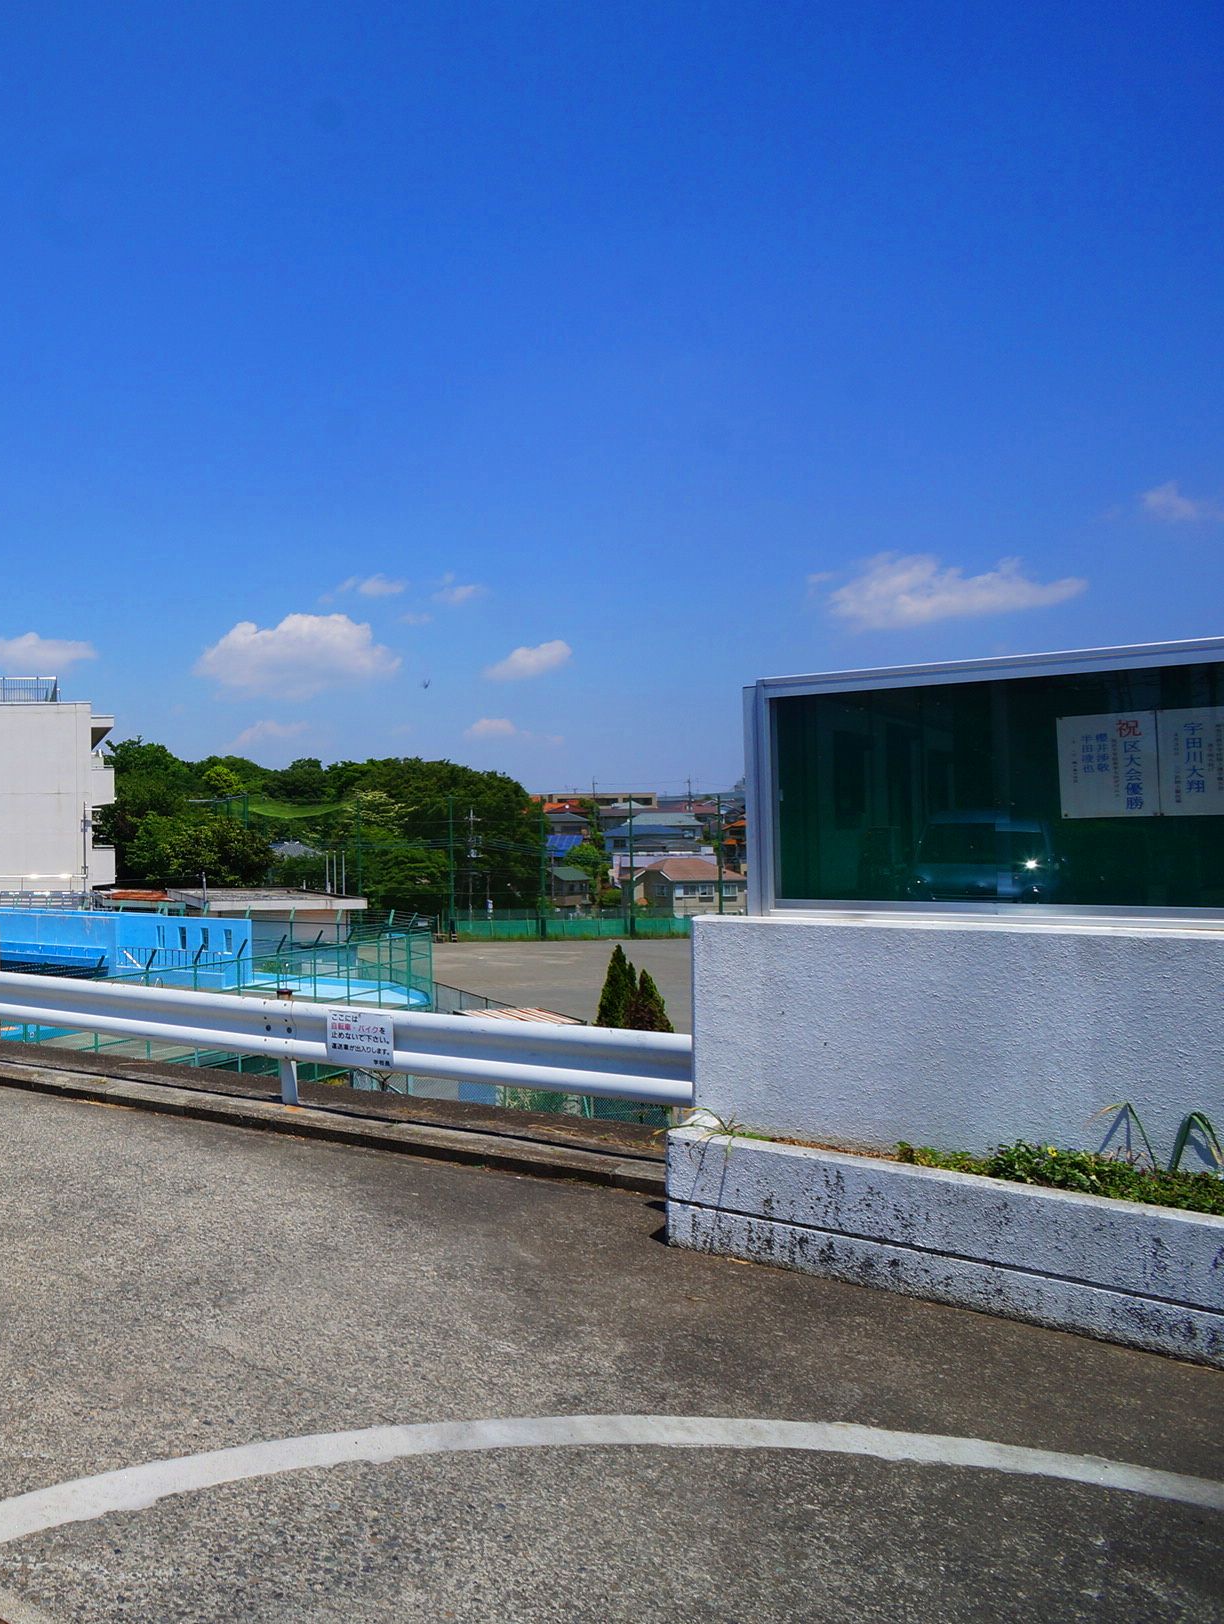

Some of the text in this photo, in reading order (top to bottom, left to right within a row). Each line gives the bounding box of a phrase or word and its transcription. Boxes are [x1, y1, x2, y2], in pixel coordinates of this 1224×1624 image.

[1116, 719, 1142, 737] 祝
[1184, 722, 1205, 793] 宇田川大翔
[331, 1013, 358, 1023] ここには
[331, 1031, 390, 1044] 止めないで下さい。
